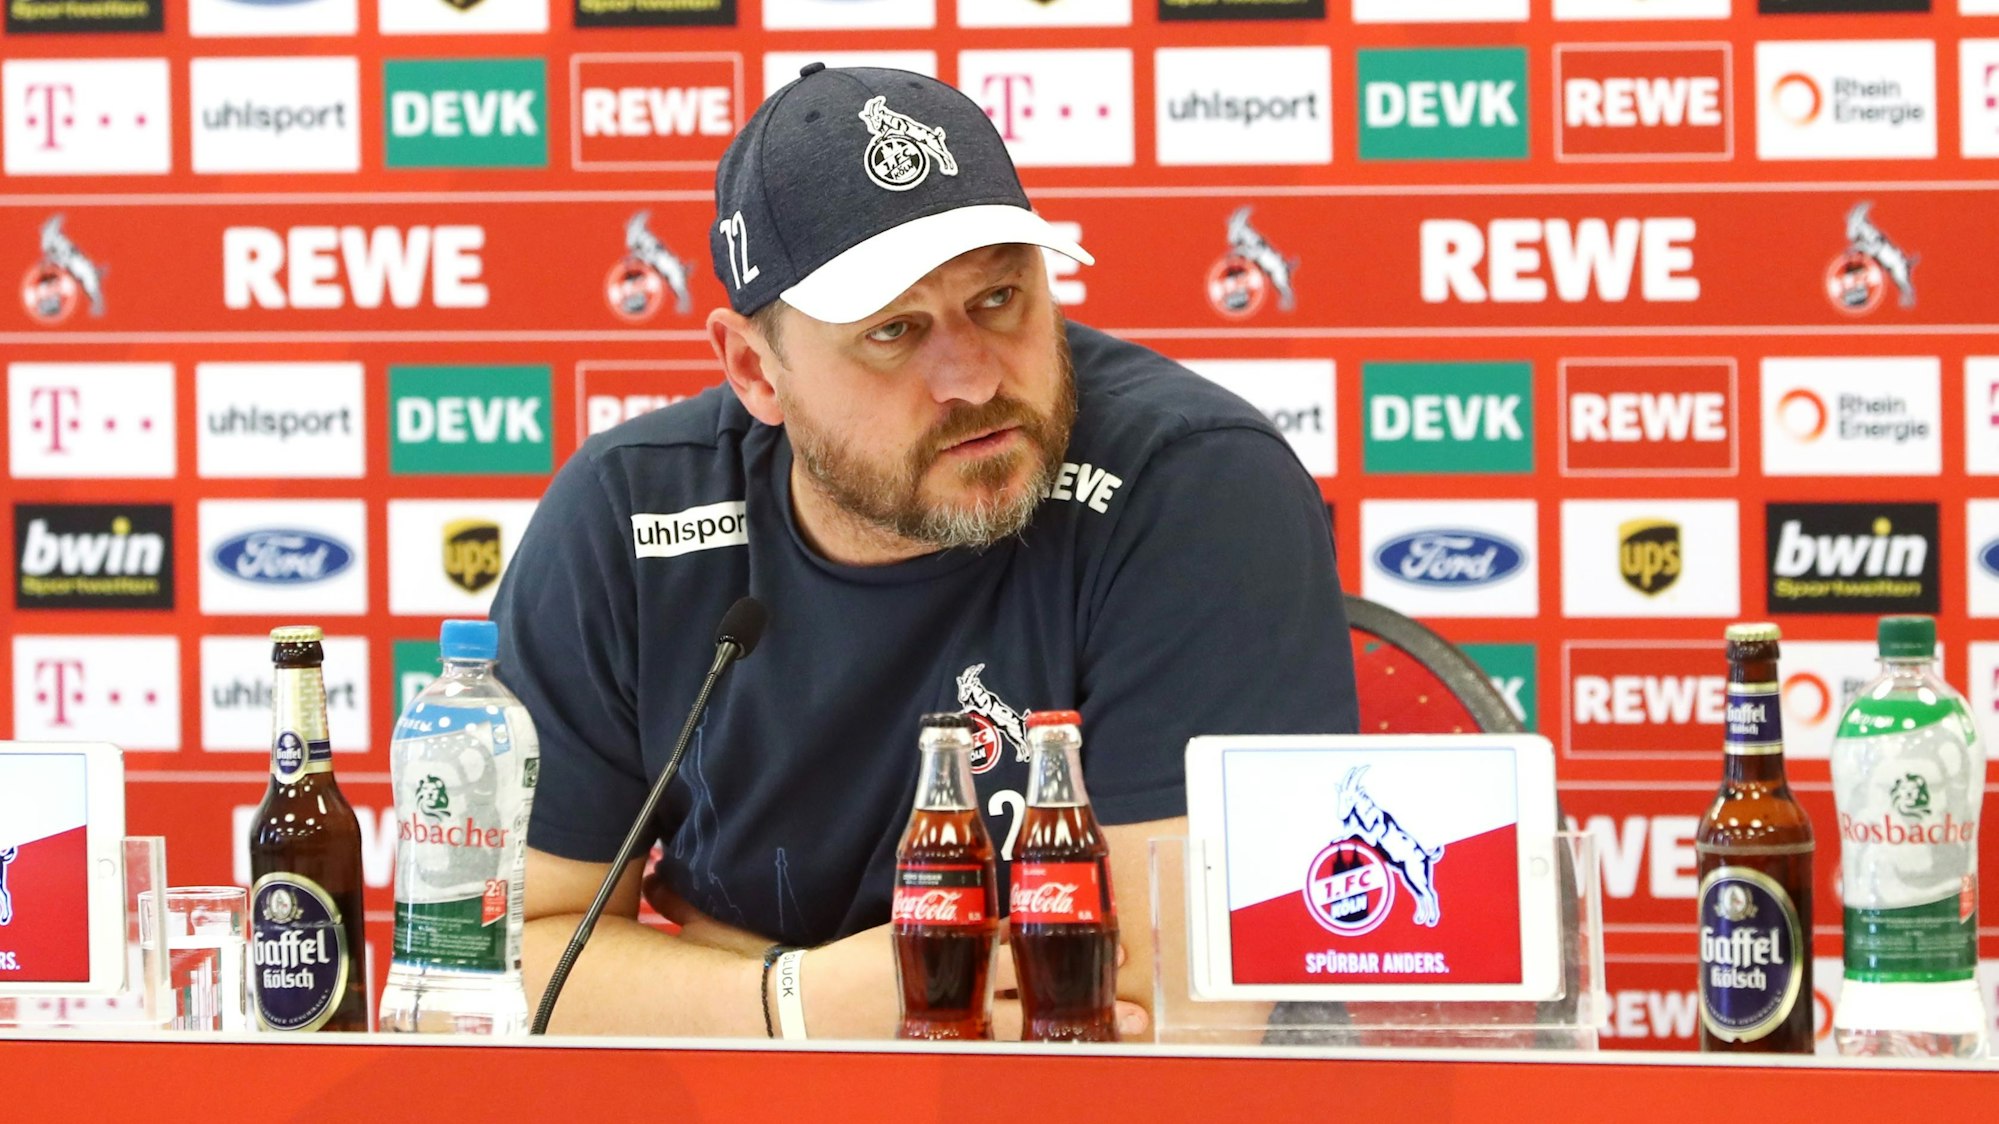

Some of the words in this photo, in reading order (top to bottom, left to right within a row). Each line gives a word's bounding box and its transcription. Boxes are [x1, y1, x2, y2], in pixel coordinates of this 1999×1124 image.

[1168, 91, 1318, 126] uhlsport
[1365, 81, 1518, 128] DEVK
[1564, 77, 1723, 127] REWE
[1833, 76, 1902, 99] Rhein
[203, 101, 346, 135] uhlsport
[391, 90, 538, 137] DEVK
[582, 86, 732, 137] REWE
[1833, 100, 1924, 125] Energie
[893, 162, 915, 179] KÖLN
[223, 225, 490, 310] REWE
[1420, 216, 1701, 303] REWE
[208, 405, 351, 441] uhlsport
[397, 396, 544, 443] DEVK
[1370, 393, 1525, 442] DEVK
[1569, 392, 1728, 442] REWE
[1838, 393, 1906, 416] Rhein
[1838, 418, 1930, 444] Energie
[22, 516, 165, 576] bwin
[234, 532, 329, 580] Ford
[444, 541, 501, 587] ups
[1400, 535, 1498, 581] Ford
[1621, 541, 1681, 589] ups
[1774, 517, 1928, 577] bwin
[1574, 675, 1727, 724] REWE
[1331, 894, 1368, 919] KÖLN
[254, 928, 331, 969] Gaffel
[1305, 948, 1380, 973] SPÜRBAR
[1382, 952, 1450, 973] ANDERS.
[1701, 925, 1785, 968] Gaffel
